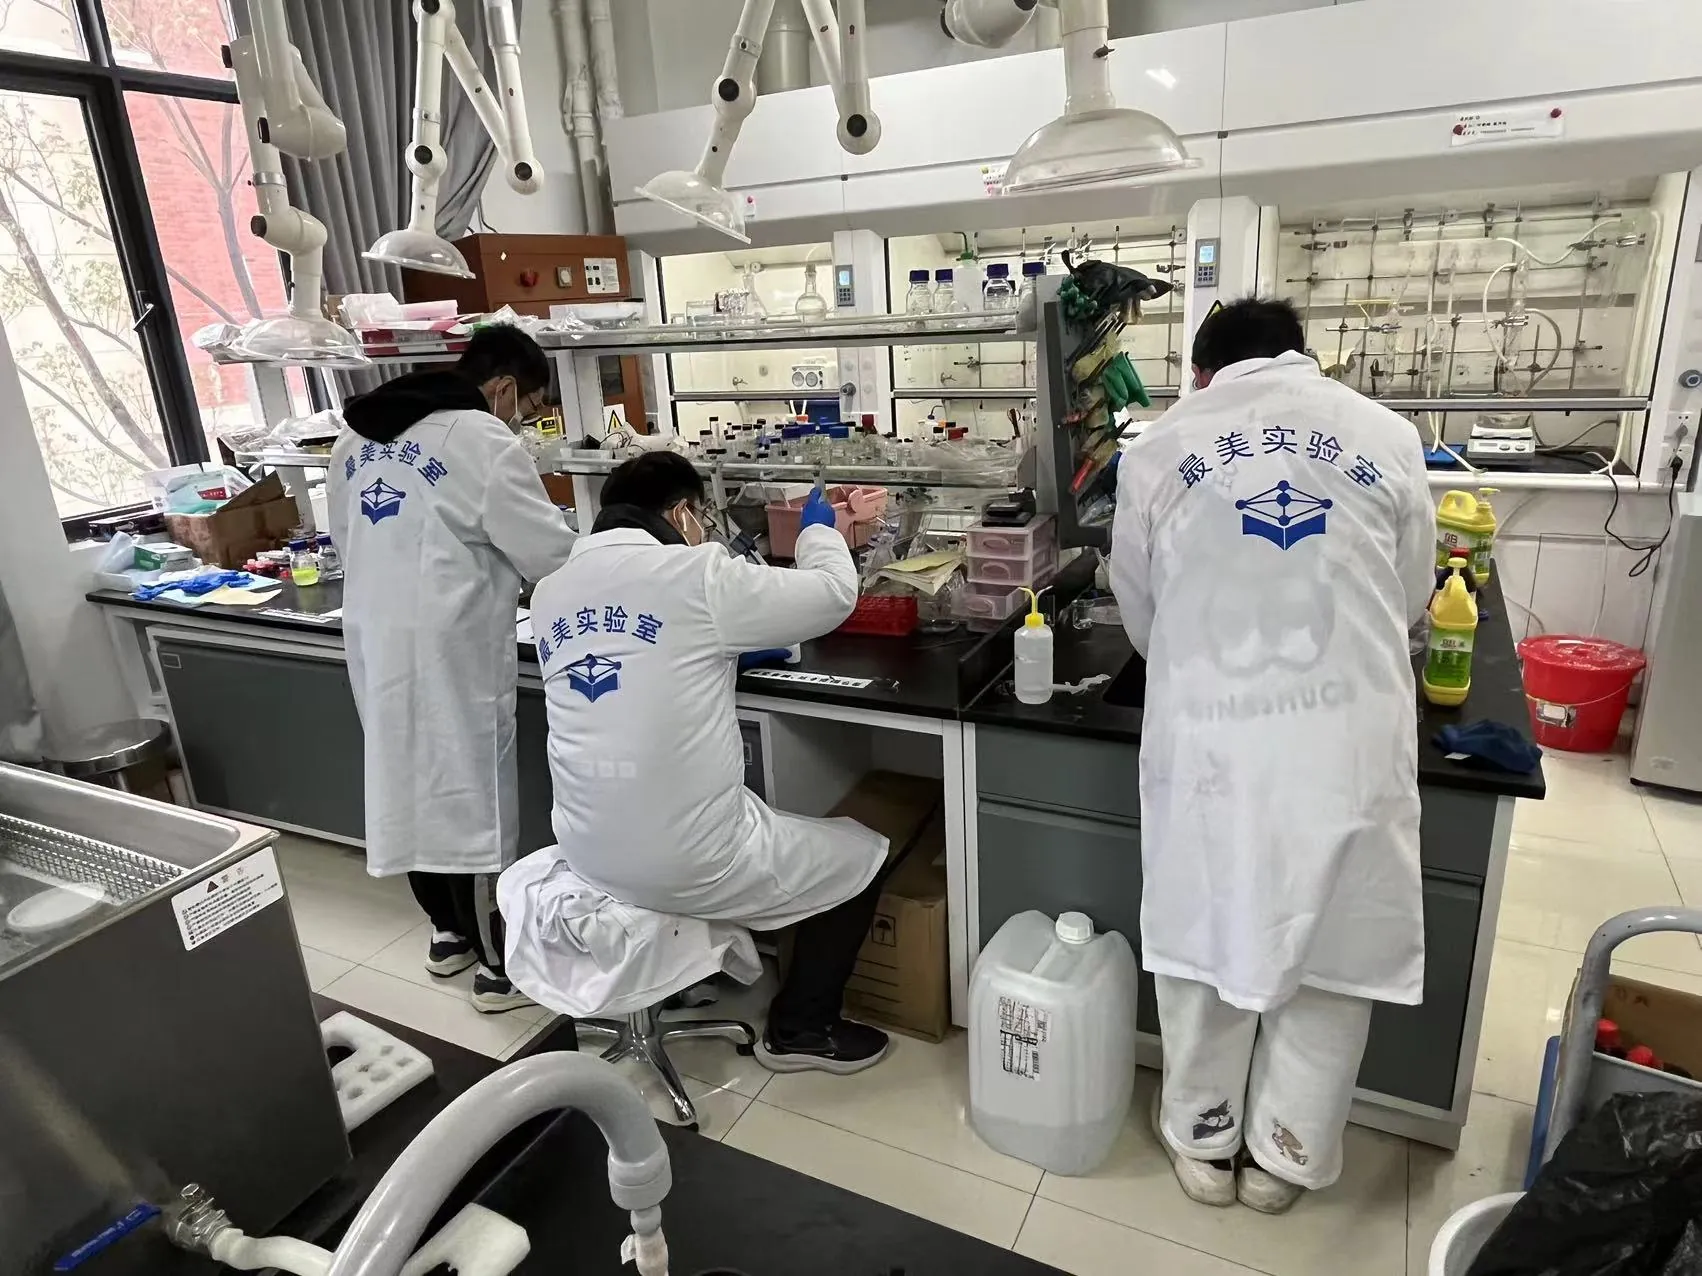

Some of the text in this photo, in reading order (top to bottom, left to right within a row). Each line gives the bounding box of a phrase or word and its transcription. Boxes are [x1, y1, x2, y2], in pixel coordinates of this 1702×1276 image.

[1178, 426, 1383, 488] 最美实验室
